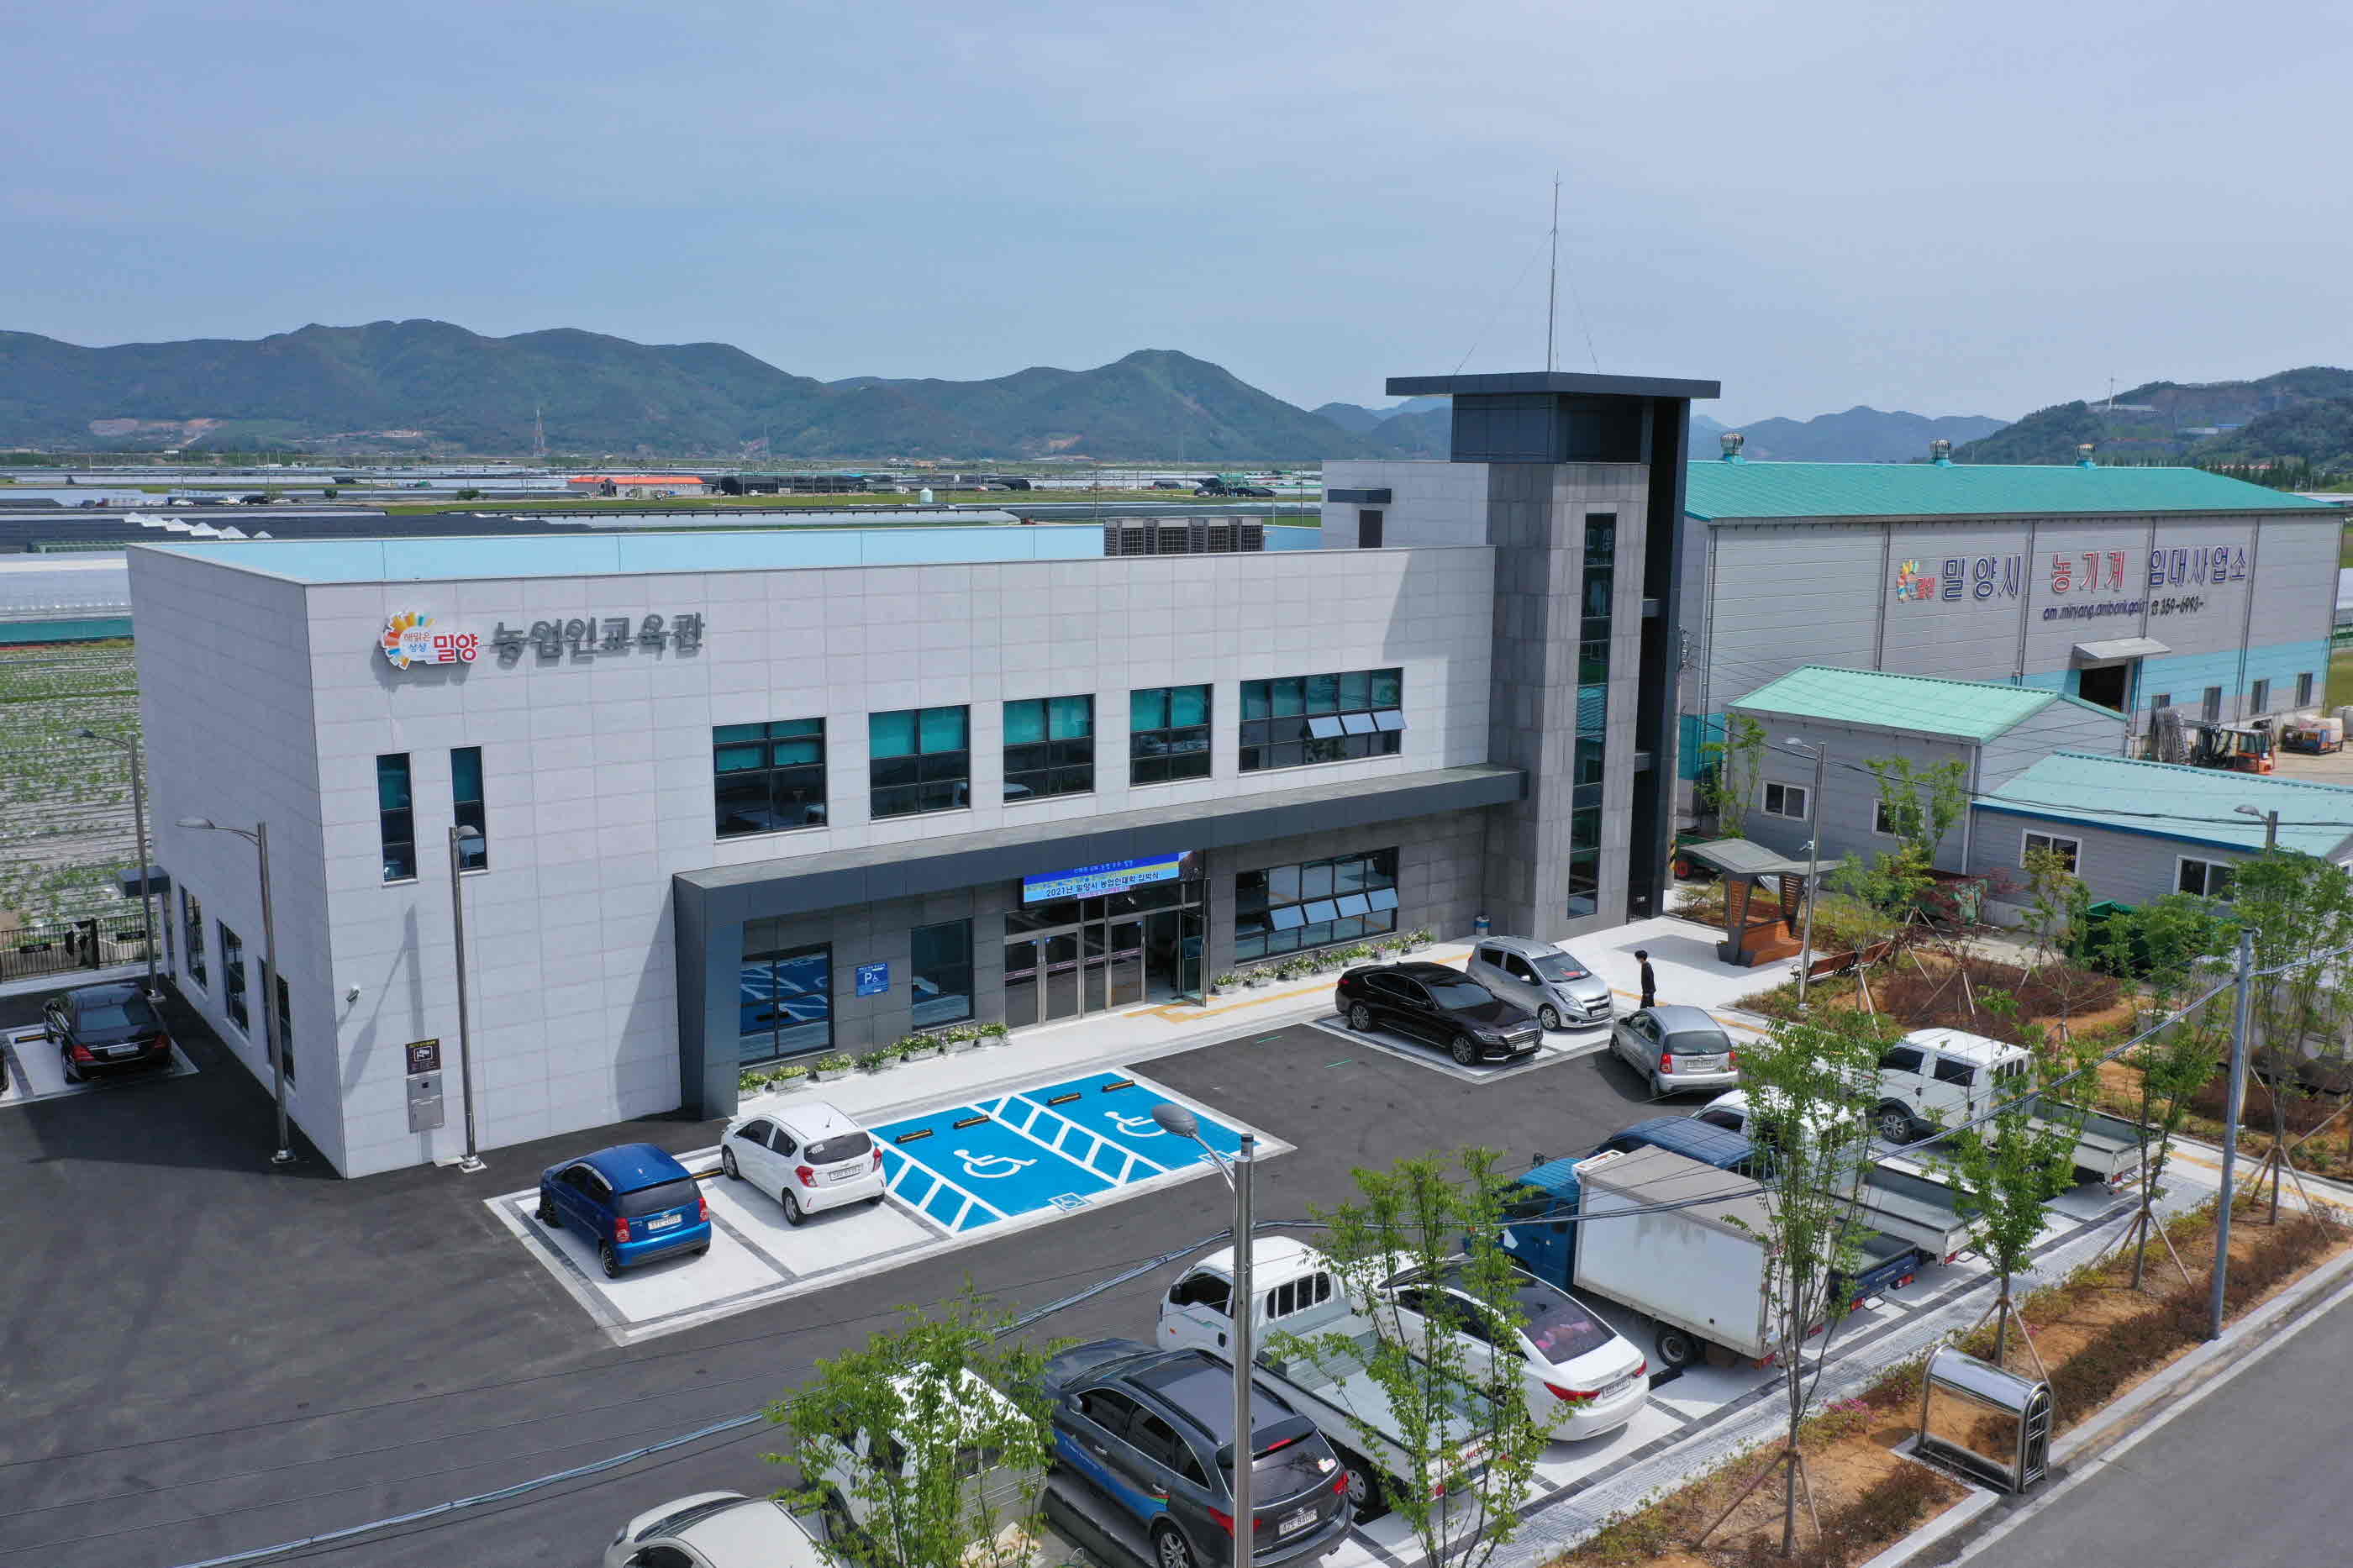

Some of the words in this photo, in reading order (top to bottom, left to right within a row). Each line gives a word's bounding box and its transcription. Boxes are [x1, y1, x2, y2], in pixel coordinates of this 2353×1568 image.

[1944, 555, 2023, 599] 밀양시
[2050, 550, 2125, 593] 농기계
[2150, 545, 2246, 586] 임대사업소
[403, 631, 431, 642] 해맑은
[492, 612, 705, 659] 농업인교육관
[434, 633, 479, 662] 밀양
[1045, 885, 1074, 897] 2021년
[865, 972, 872, 985] P
